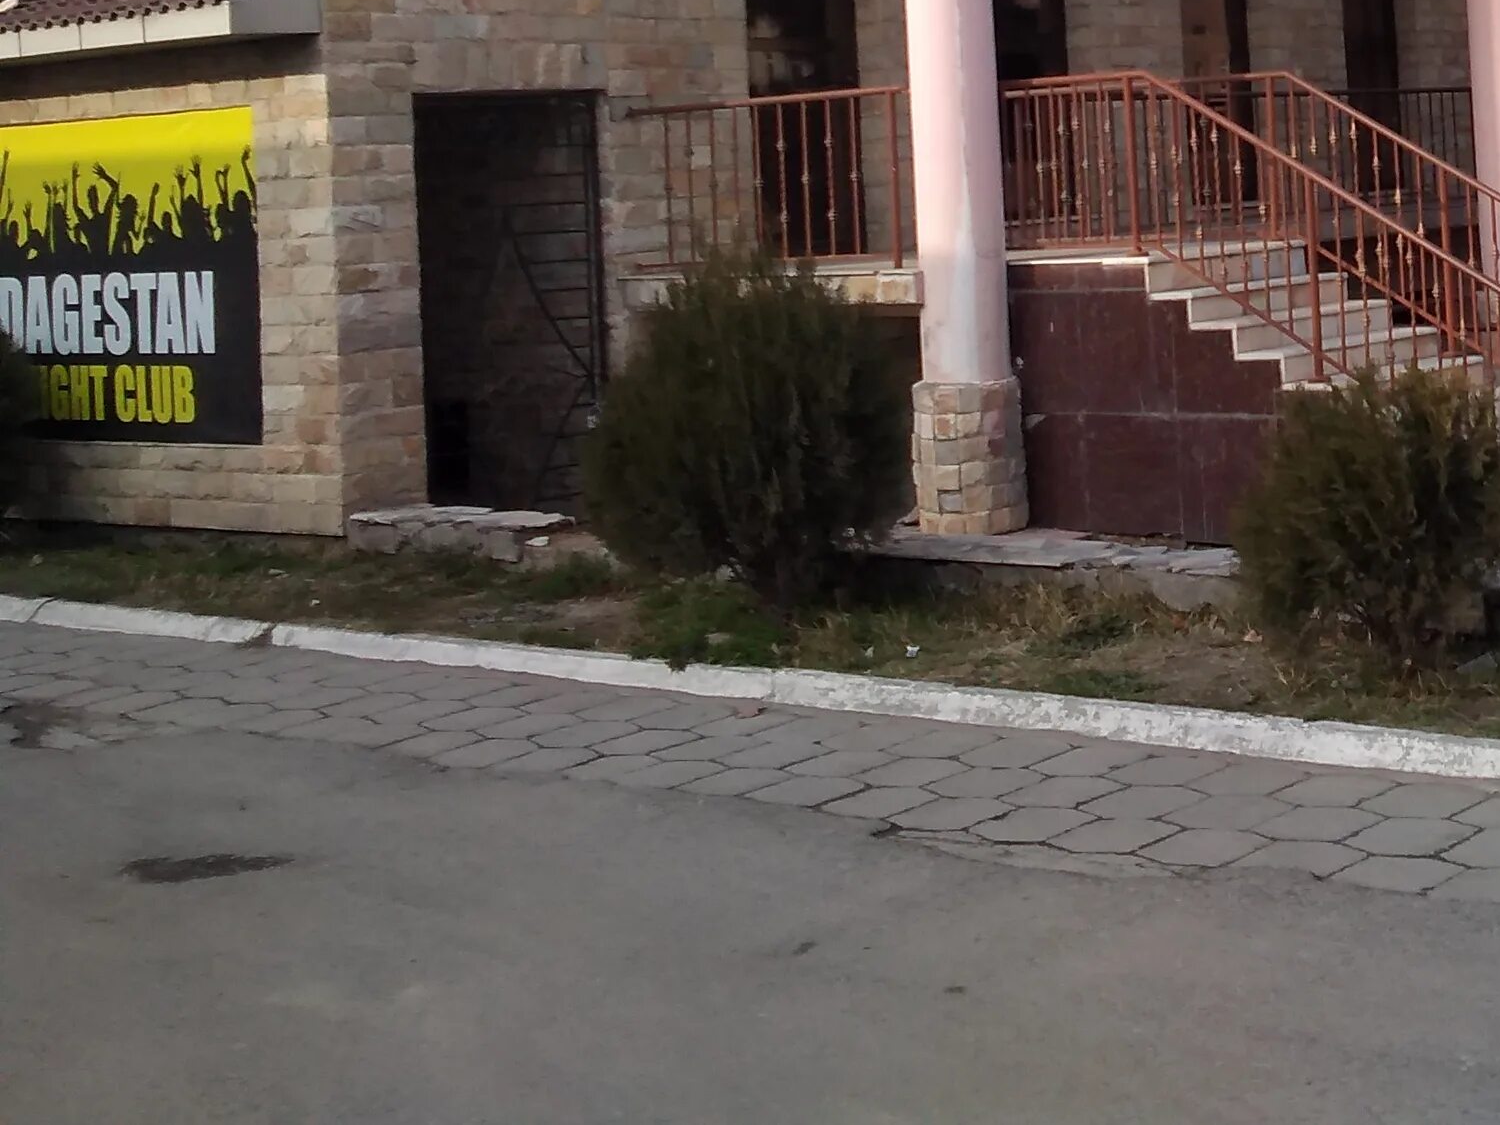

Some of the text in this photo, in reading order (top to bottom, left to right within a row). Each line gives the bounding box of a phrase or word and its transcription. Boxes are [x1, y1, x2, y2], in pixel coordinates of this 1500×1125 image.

[0, 271, 216, 356] DAGESTAN
[32, 364, 196, 424] IGHT CLUB
